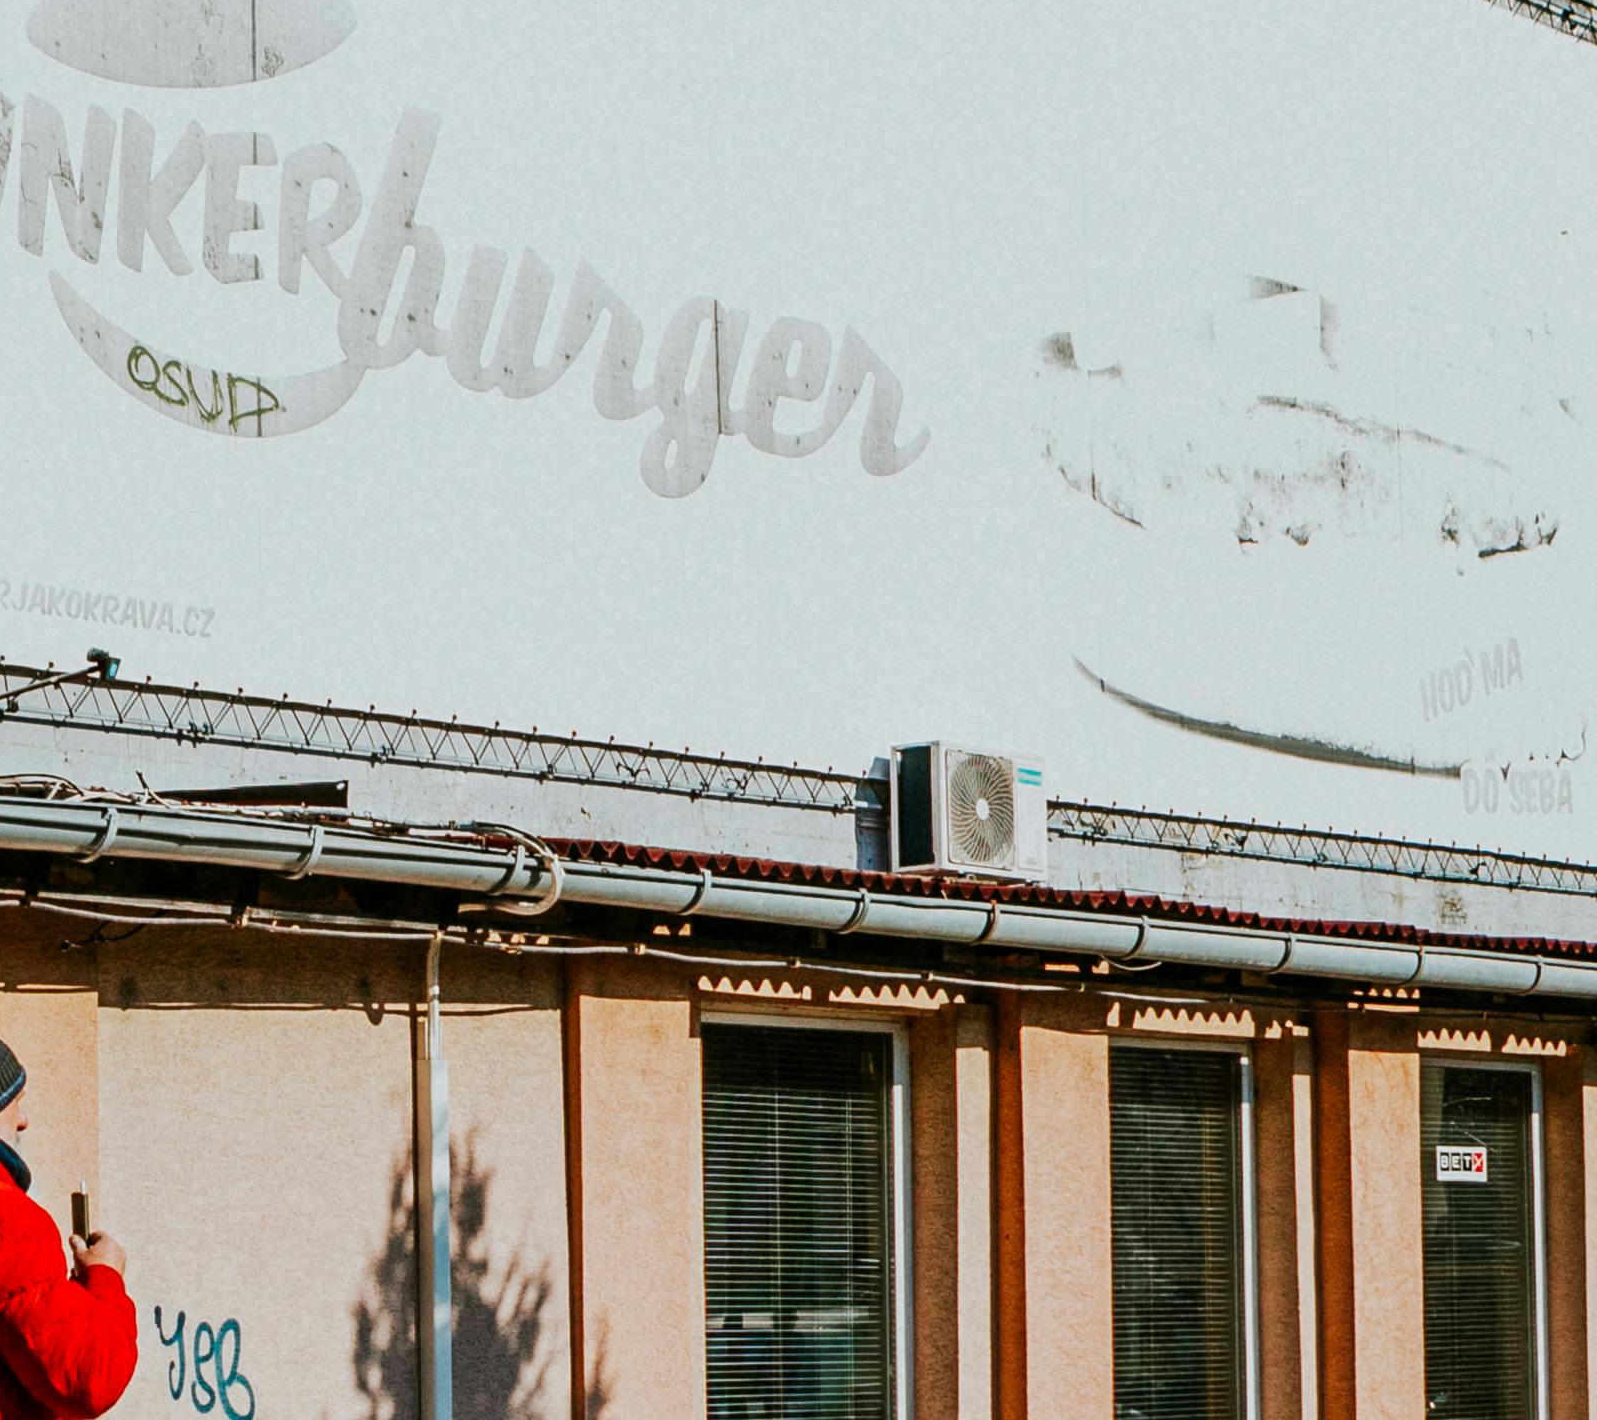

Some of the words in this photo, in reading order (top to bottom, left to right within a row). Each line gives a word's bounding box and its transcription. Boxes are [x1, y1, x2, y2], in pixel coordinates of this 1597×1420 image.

[1480, 636, 1523, 697] MA
[1462, 768, 1499, 815] DO
[1508, 768, 1573, 815] SEBA
[1440, 1152, 1484, 1172] BETX
